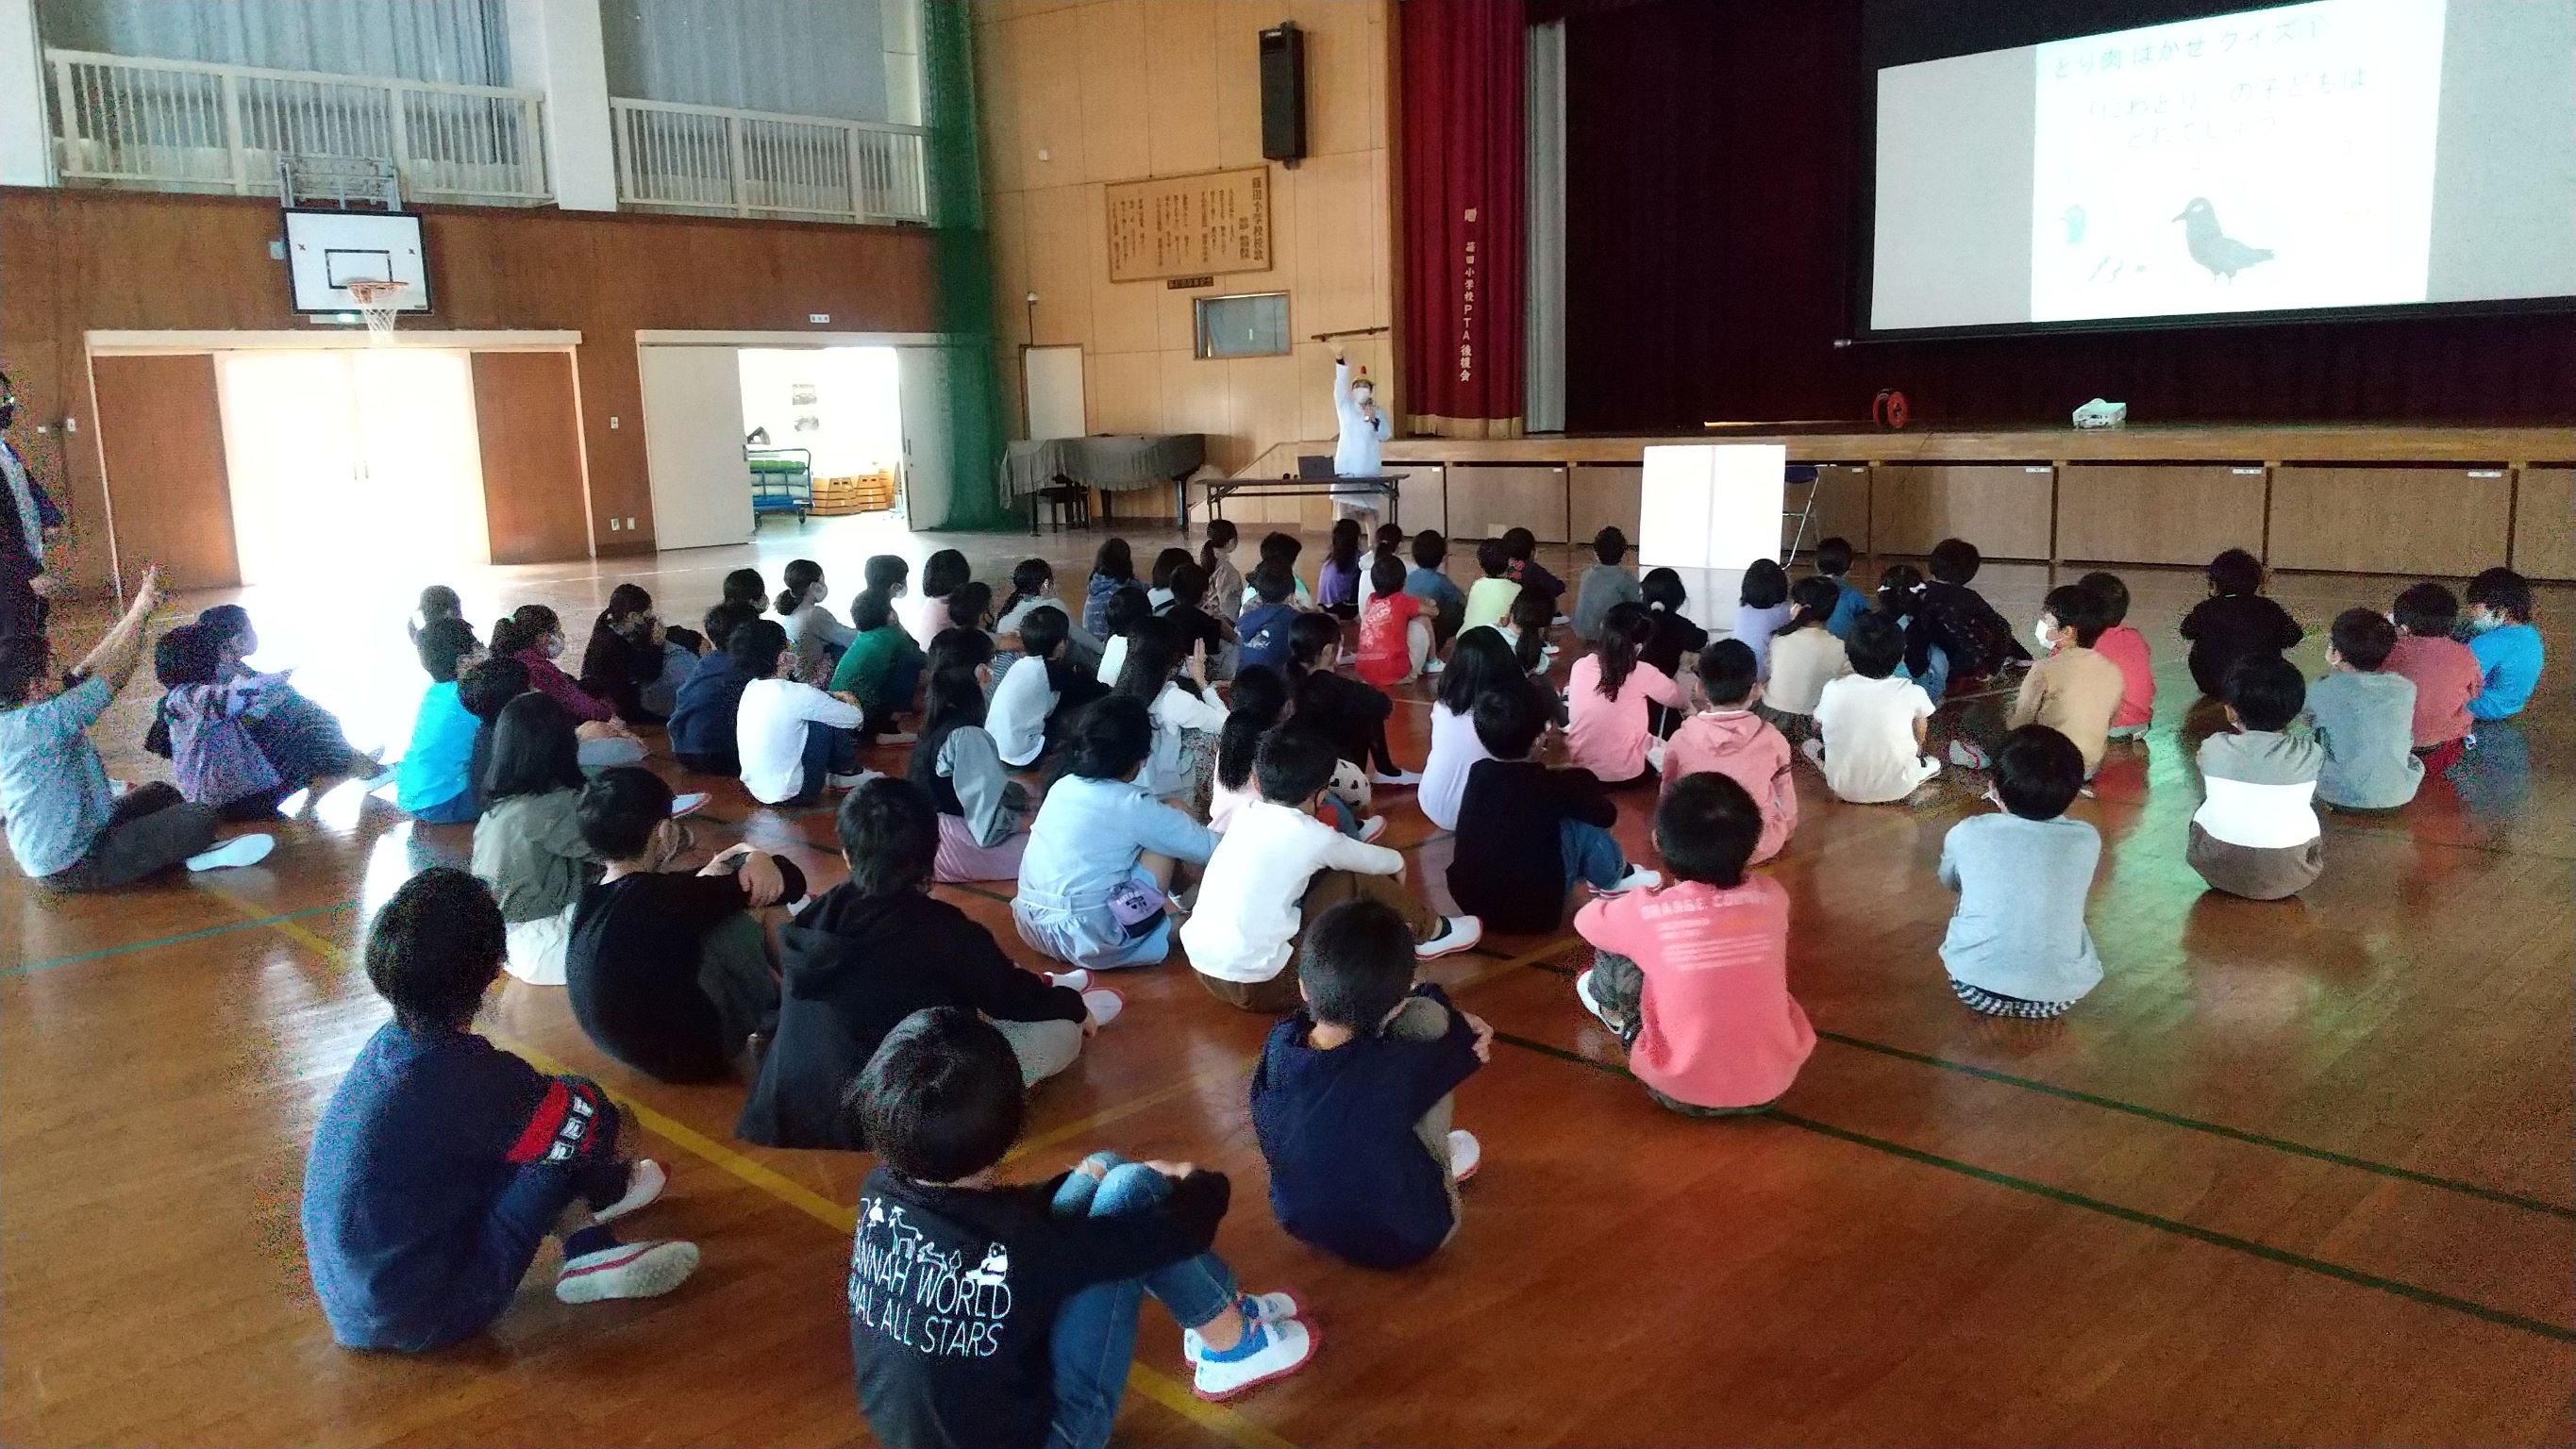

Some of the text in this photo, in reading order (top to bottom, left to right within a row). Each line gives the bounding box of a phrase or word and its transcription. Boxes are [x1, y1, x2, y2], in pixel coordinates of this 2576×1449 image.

[916, 1265, 1012, 1320] WORLD
[880, 1298, 912, 1346] ALL
[920, 1315, 1004, 1357] STARS
